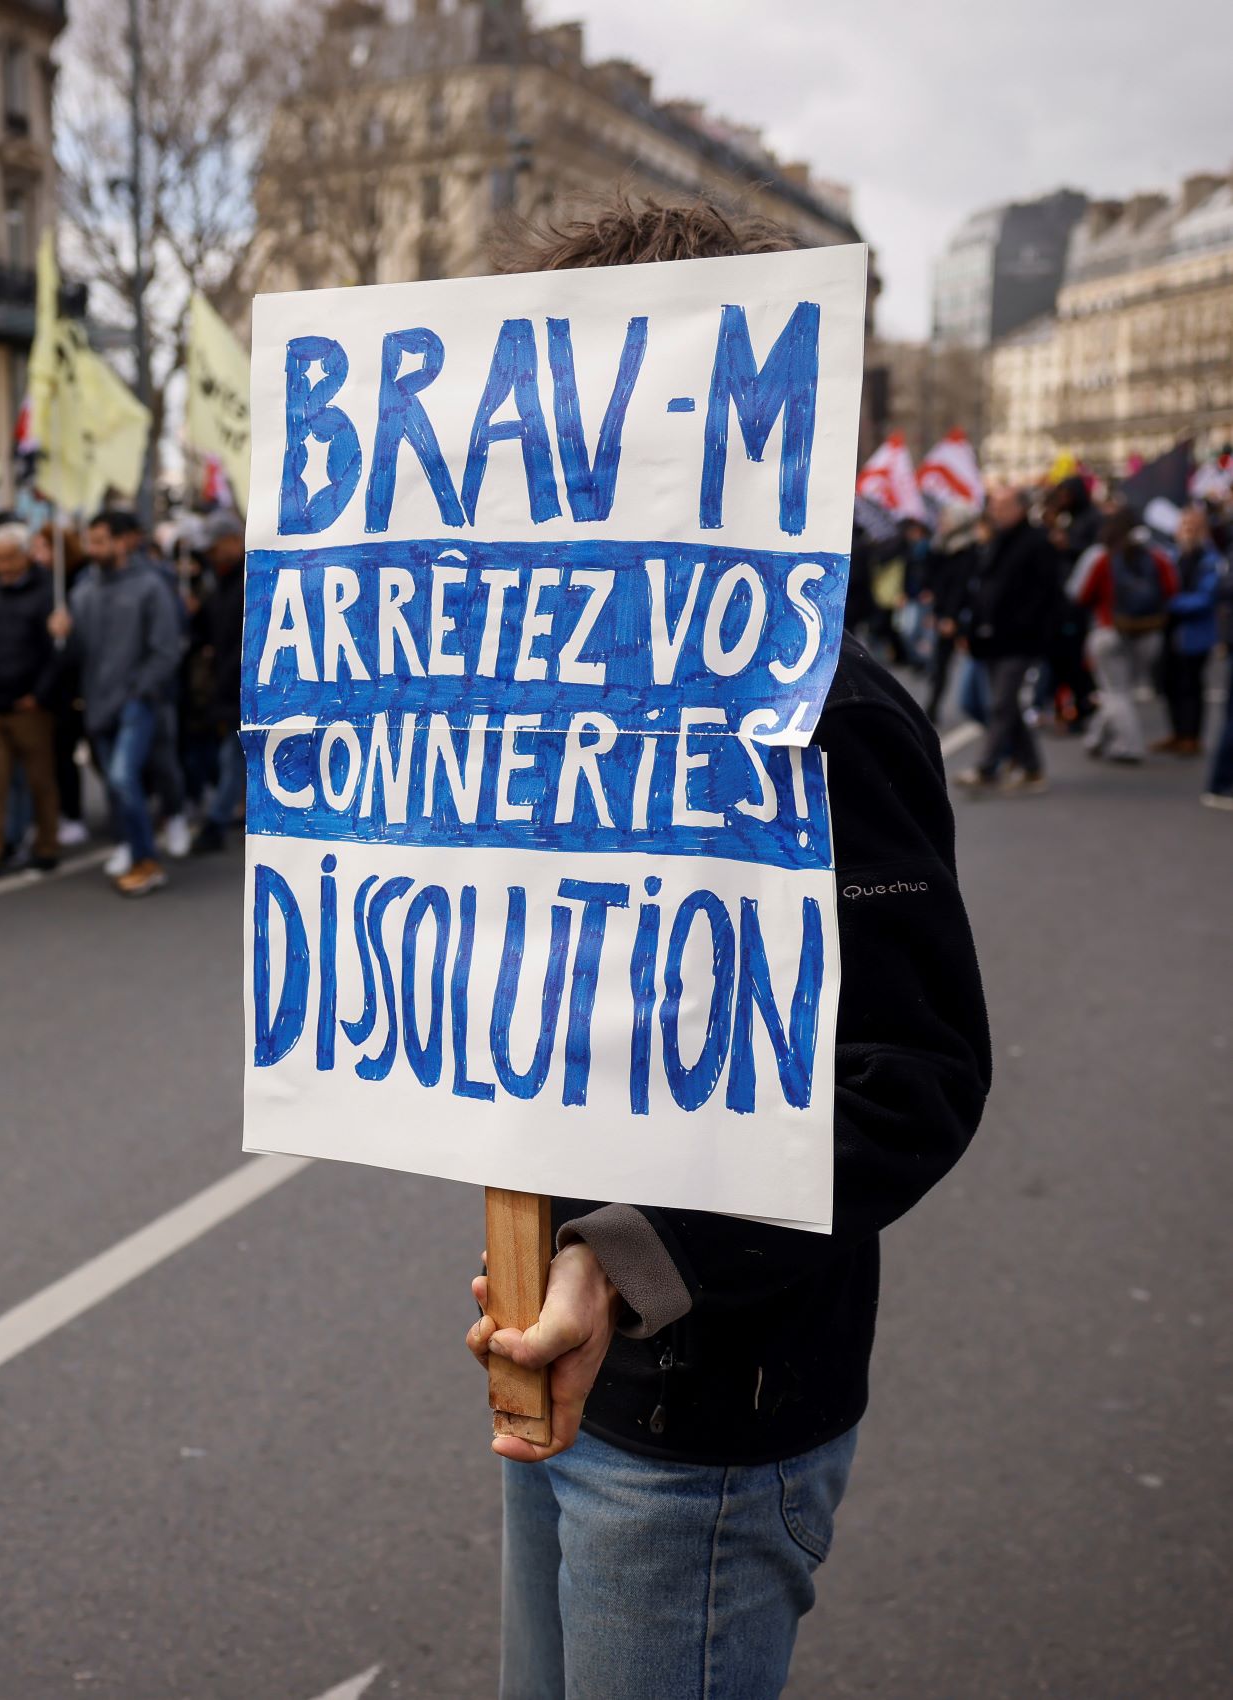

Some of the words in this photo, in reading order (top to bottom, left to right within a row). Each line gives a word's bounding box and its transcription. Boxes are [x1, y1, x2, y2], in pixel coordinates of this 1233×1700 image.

[277, 301, 821, 536] BRAV-M
[258, 549, 615, 686] ARRÊTEZ
[645, 558, 826, 685] VOS
[842, 880, 929, 900] Quechua
